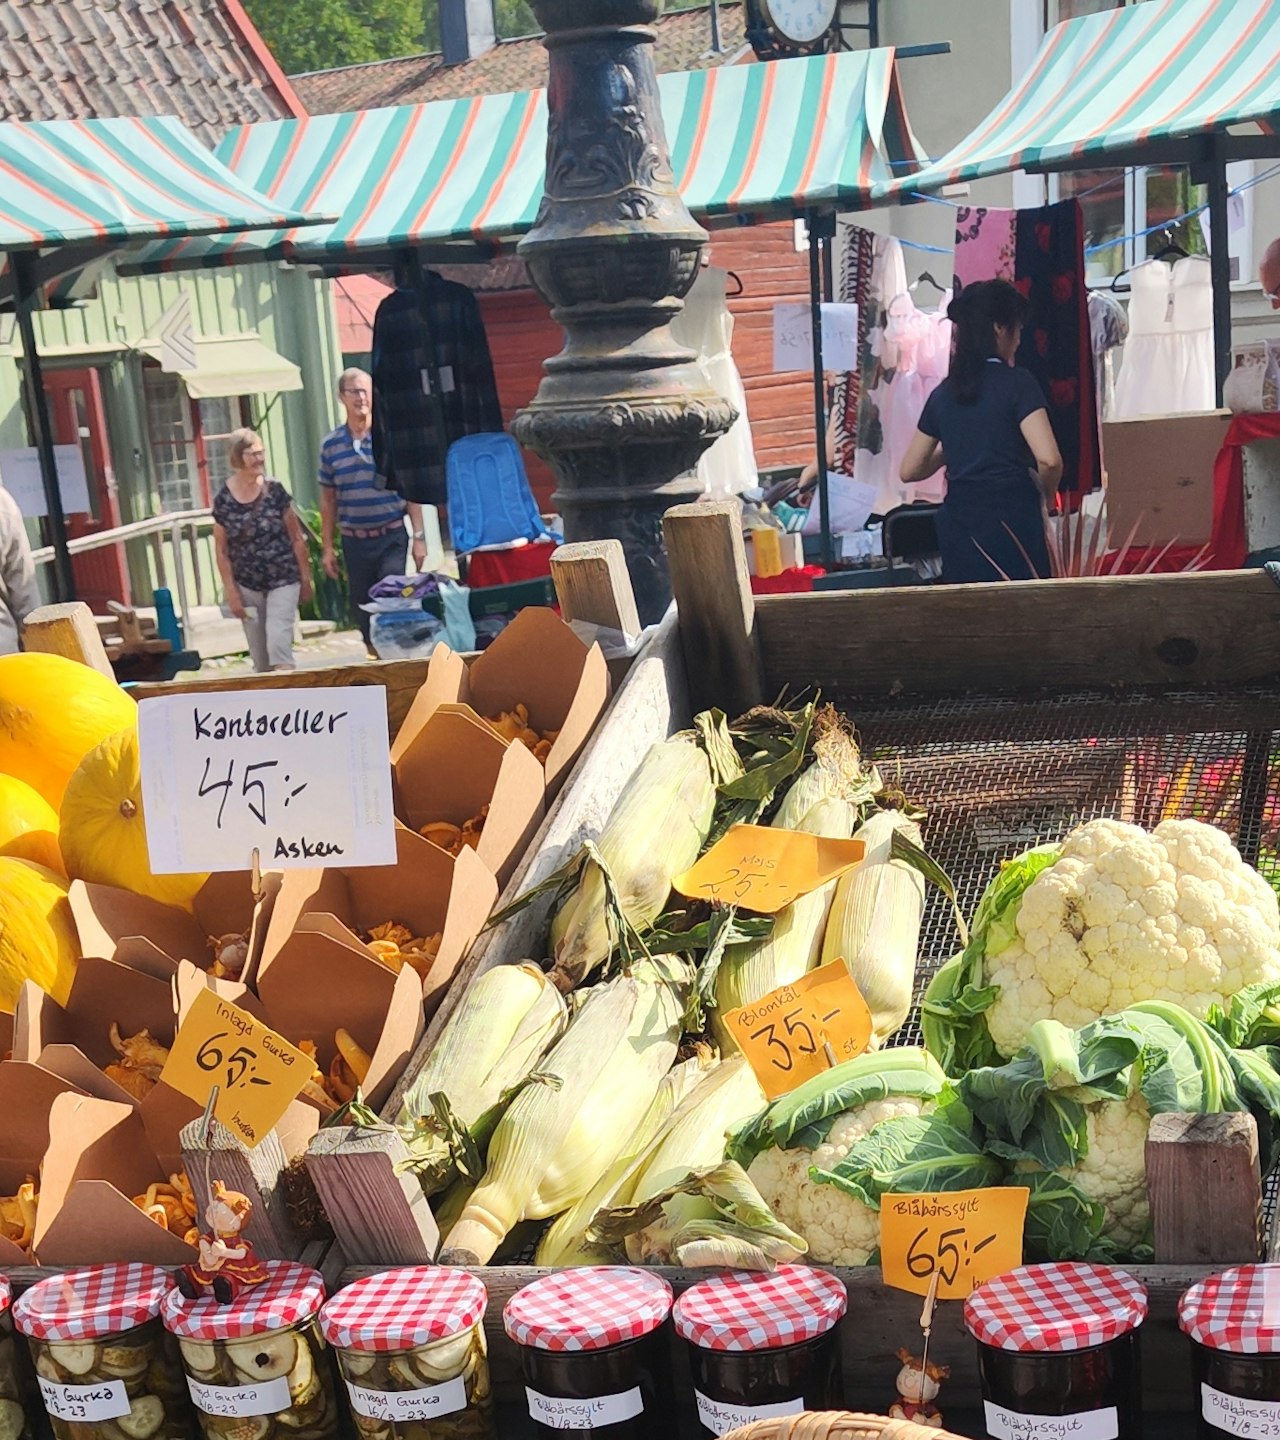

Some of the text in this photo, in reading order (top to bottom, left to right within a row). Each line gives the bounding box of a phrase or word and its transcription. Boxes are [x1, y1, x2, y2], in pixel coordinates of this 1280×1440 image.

[193, 706, 349, 741] Kantareller
[197, 756, 309, 830] 45:-
[273, 836, 345, 860] Asken
[737, 985, 802, 1028] Blomkål
[215, 1001, 255, 1037] Inlagd
[842, 1036, 859, 1055] st
[892, 1196, 981, 1221] Blåbärssylt
[62, 1386, 115, 1404] Gurka
[214, 1390, 258, 1403] Gurka
[352, 1384, 441, 1408] Inlagd Gurka
[1223, 1412, 1280, 1436] 17/8-23
